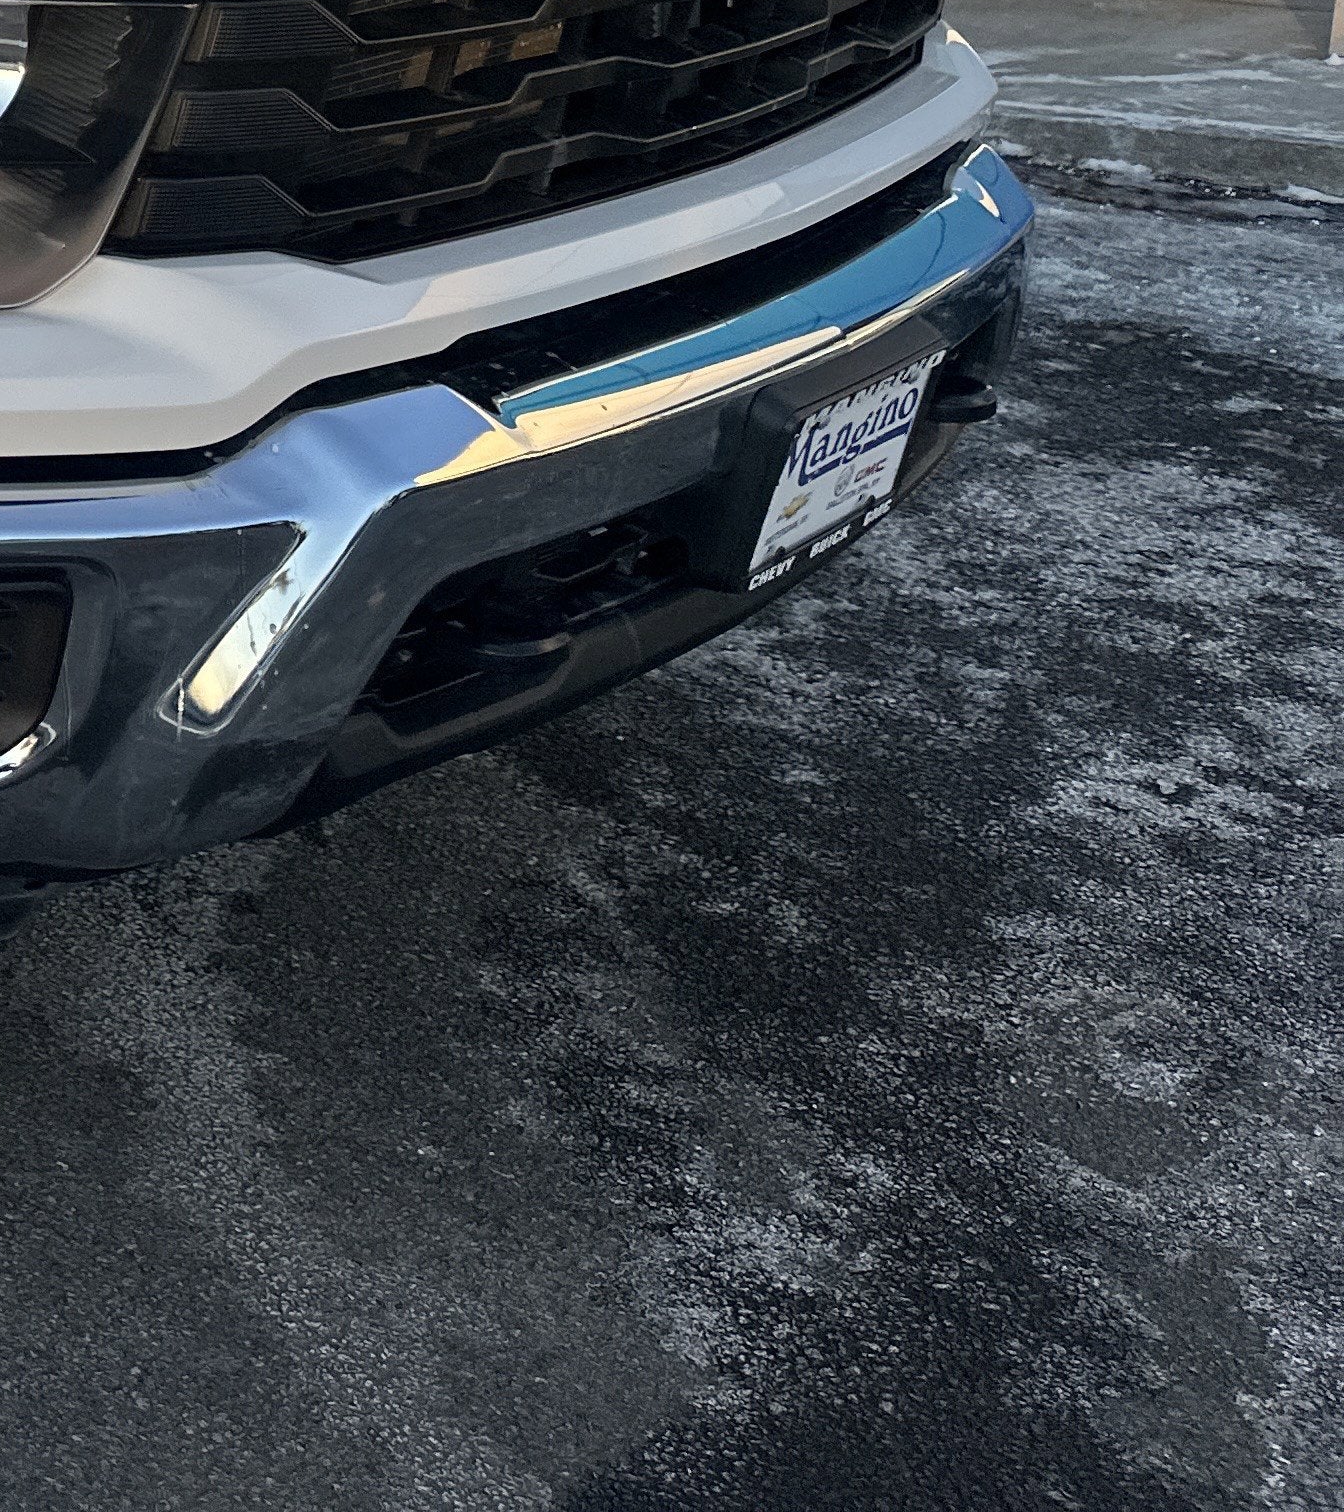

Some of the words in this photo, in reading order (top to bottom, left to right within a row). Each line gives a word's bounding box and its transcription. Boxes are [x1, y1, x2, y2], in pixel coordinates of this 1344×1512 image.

[787, 387, 919, 486] Mangino
[748, 554, 797, 591] CHEVY
[809, 523, 851, 558] BUICK
